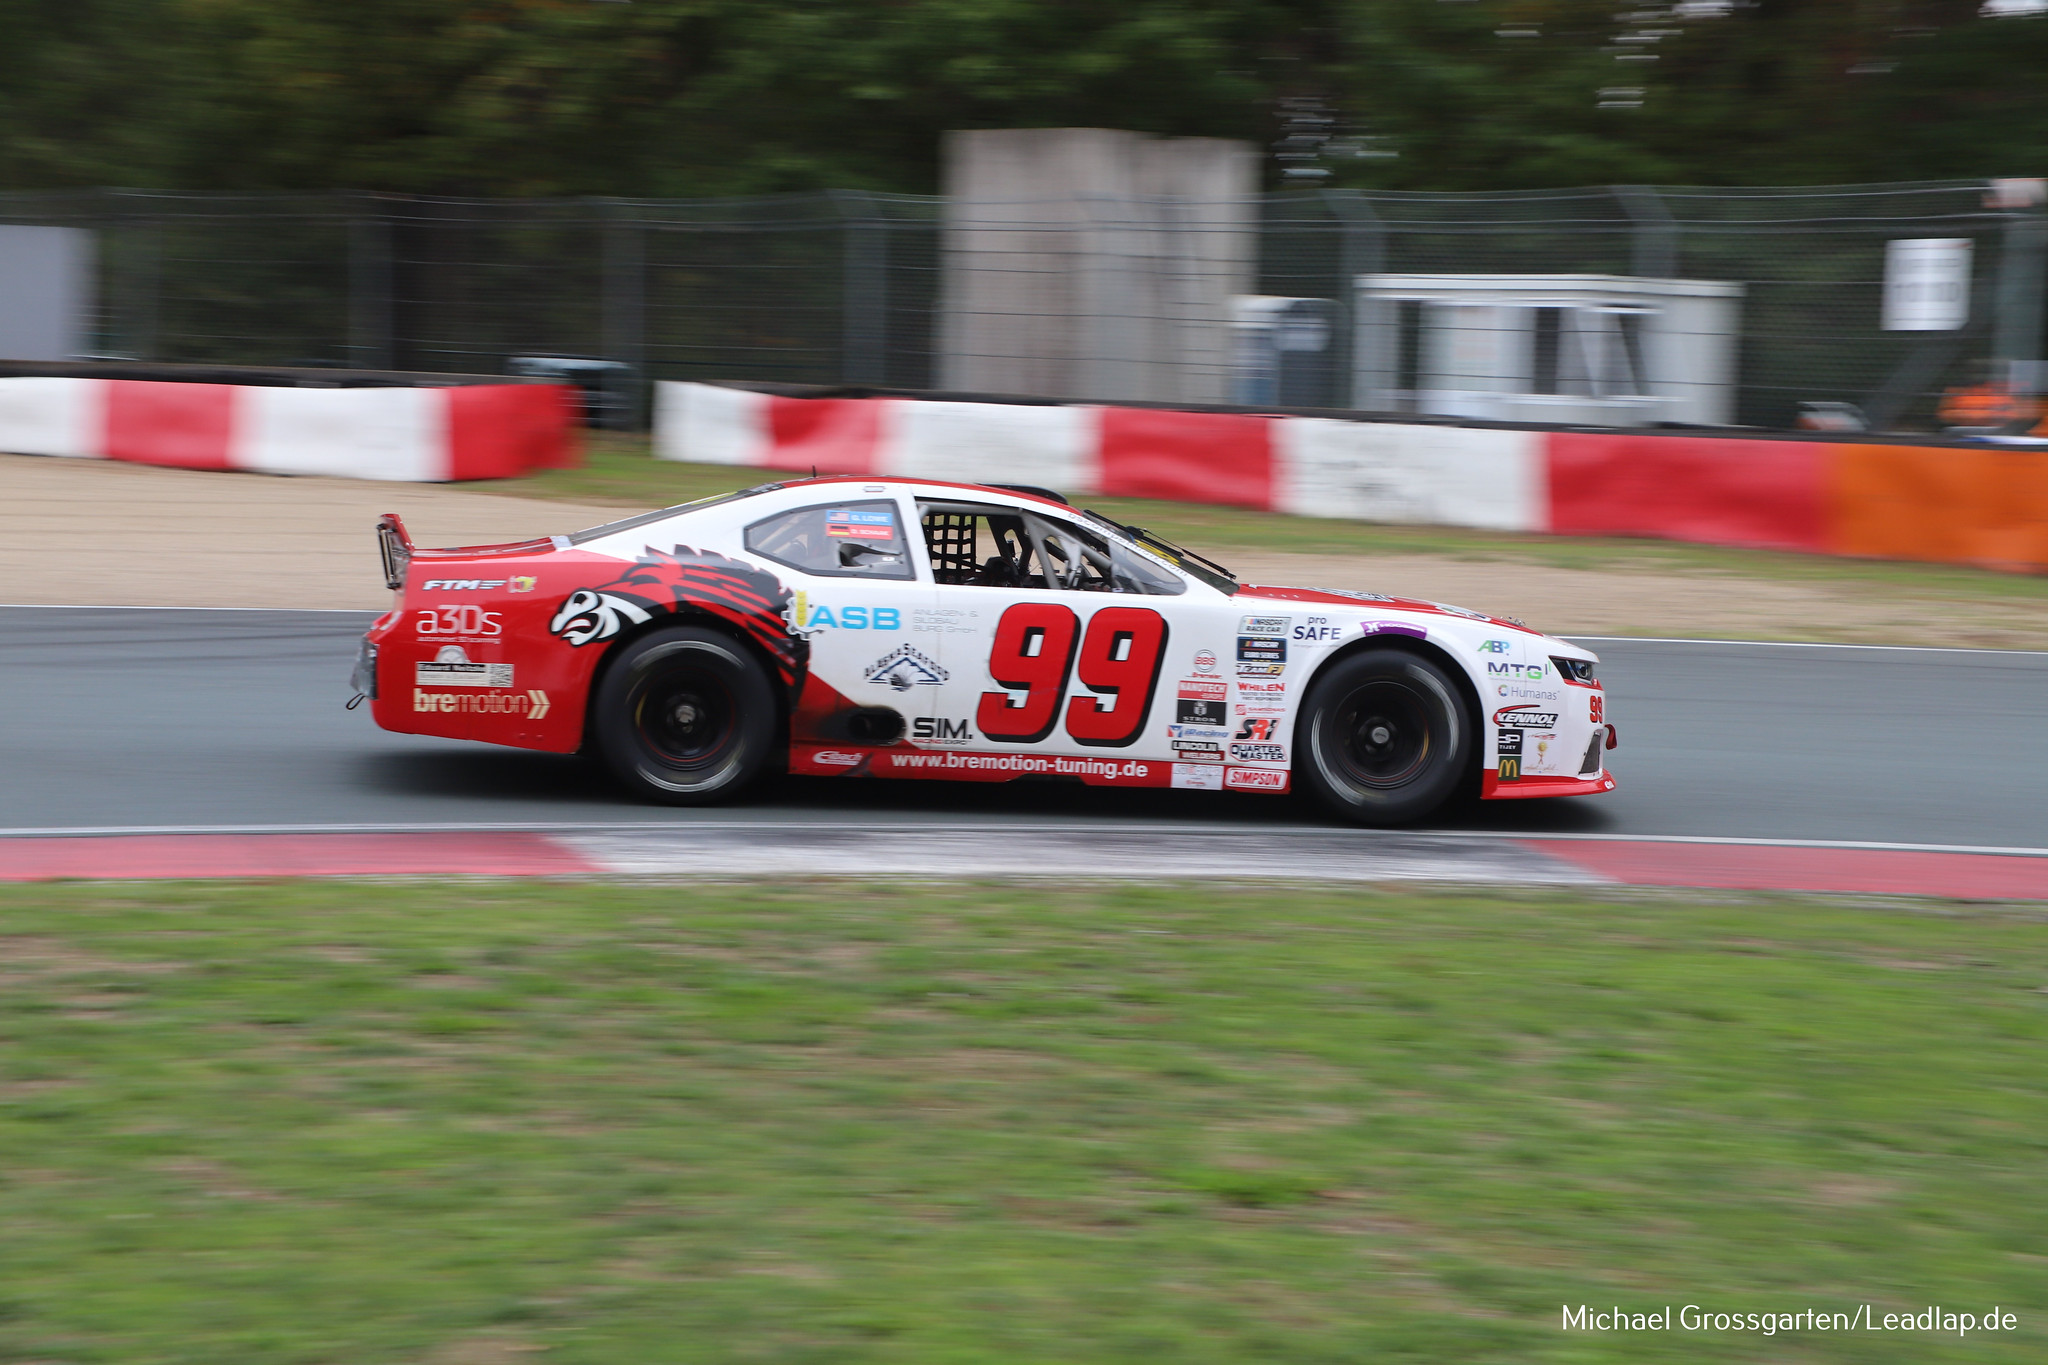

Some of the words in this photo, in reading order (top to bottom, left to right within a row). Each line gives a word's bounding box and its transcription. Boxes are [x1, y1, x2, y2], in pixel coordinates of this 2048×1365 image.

[422, 579, 481, 591] FTM
[416, 604, 503, 635] a3Ds
[808, 605, 901, 631] ASB
[1308, 616, 1327, 625] pro
[1293, 625, 1342, 641] SAFE
[1477, 639, 1511, 653] ABP
[1194, 656, 1217, 666] BBS
[976, 602, 1170, 748] 99
[1487, 661, 1543, 680] MTG
[1236, 681, 1286, 692] WHELEN
[1511, 686, 1558, 701] Humanas
[413, 687, 529, 714] bremotion
[1589, 695, 1603, 724] 99
[1496, 712, 1556, 724] KENNOL
[1184, 728, 1230, 738] iRacing
[1173, 741, 1217, 752] LINCOLN
[1231, 744, 1282, 755] QUARTER
[1181, 751, 1222, 760] WELDERS
[1240, 752, 1285, 760] MASTER
[892, 754, 1148, 779] www.bremotion-tuning.de
[1231, 770, 1282, 786] SIMPSON
